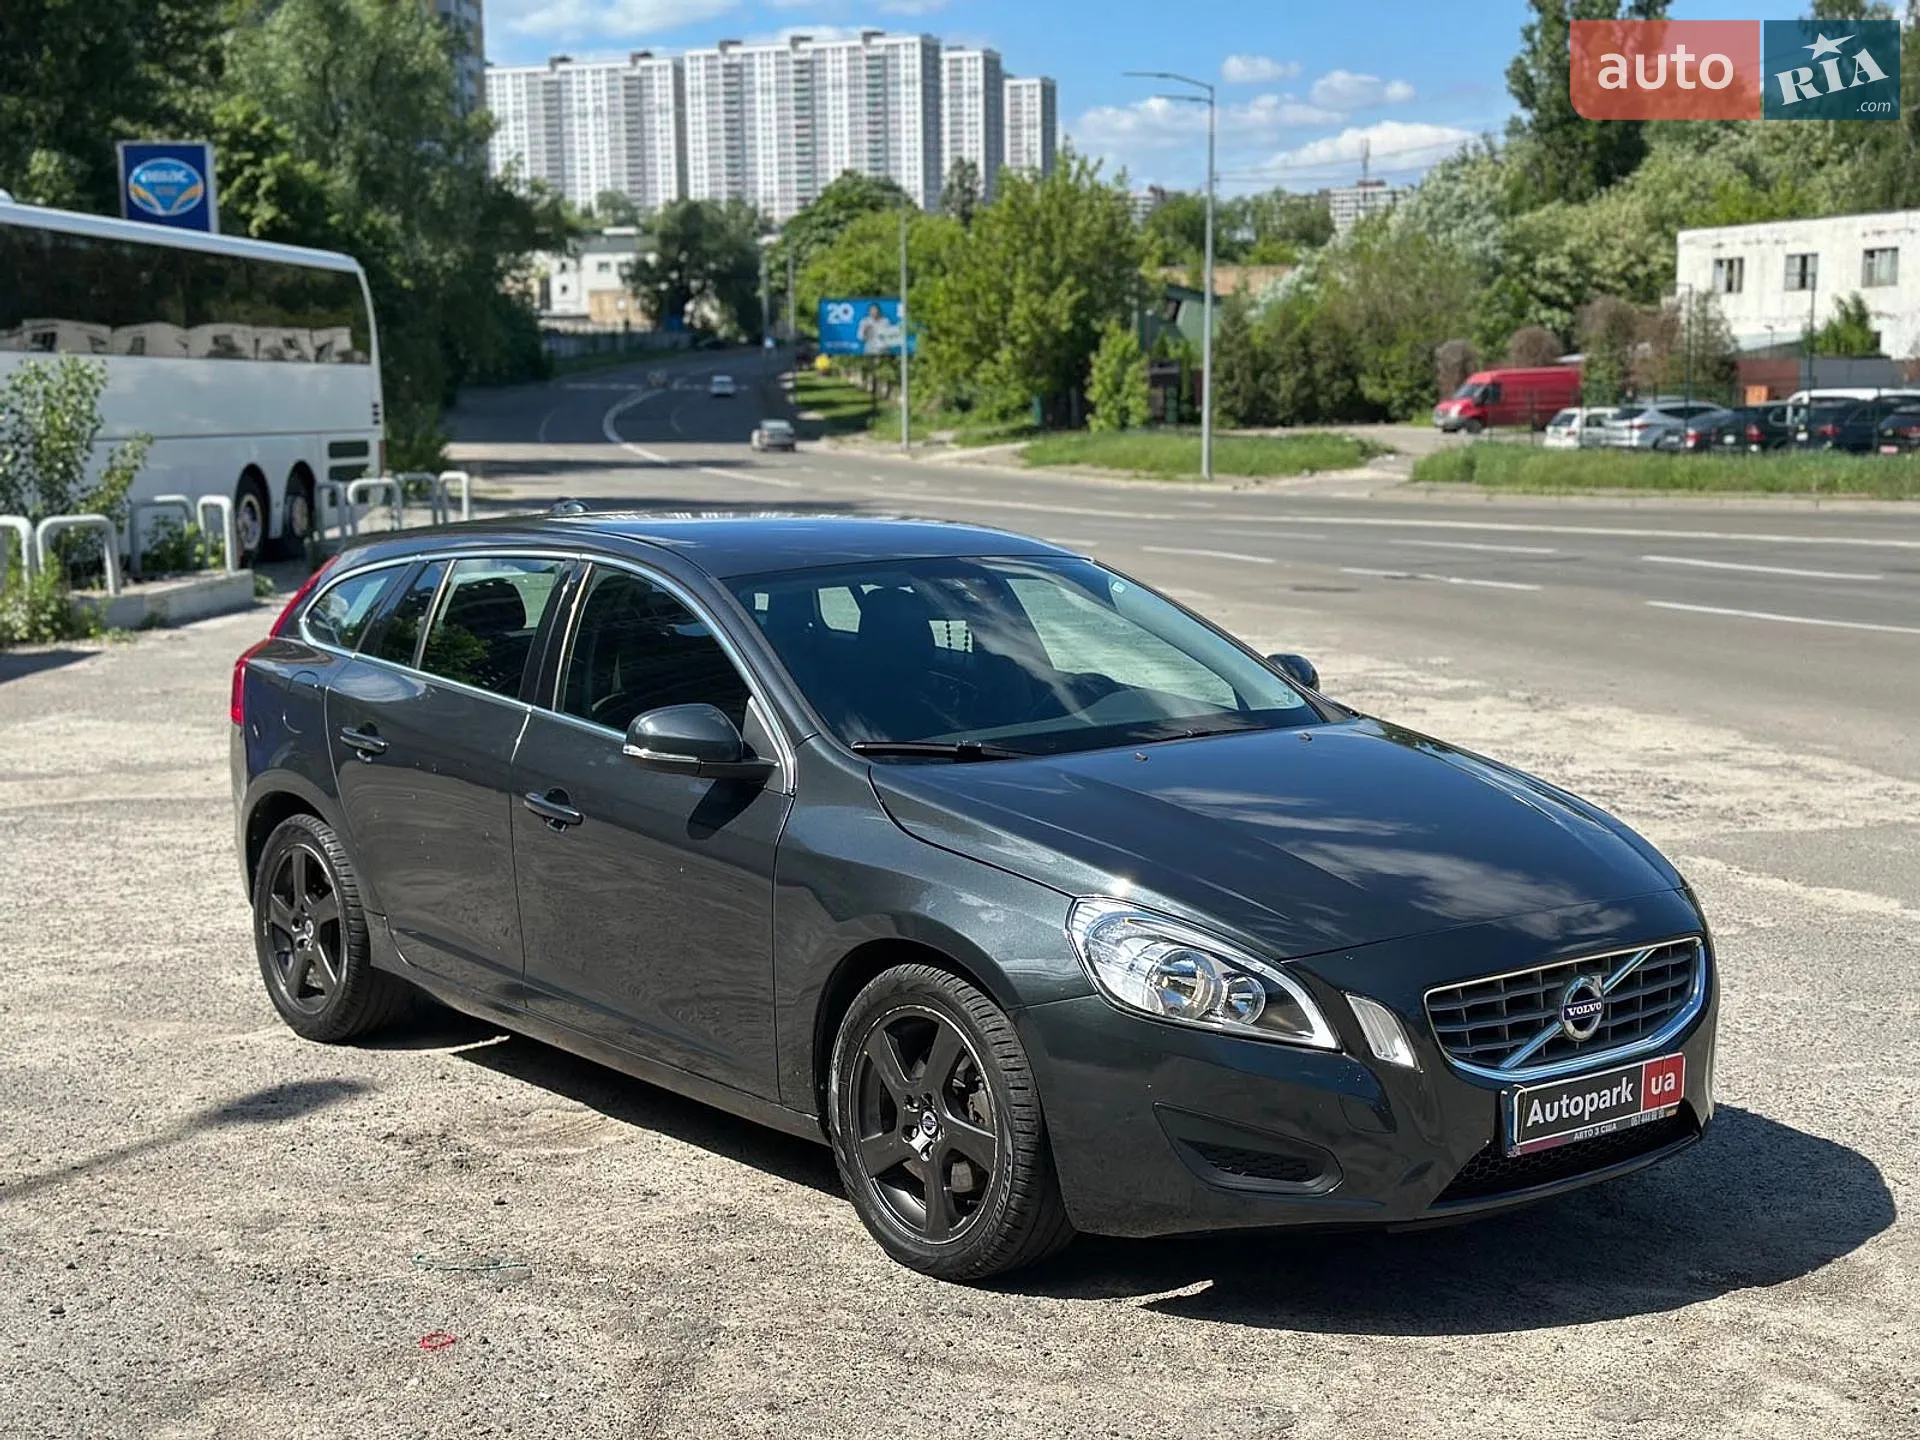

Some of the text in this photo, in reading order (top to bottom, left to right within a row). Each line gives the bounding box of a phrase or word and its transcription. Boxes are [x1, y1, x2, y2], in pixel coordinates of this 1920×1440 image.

[1567, 1002, 1602, 1016] VOLVO
[1526, 1072, 1675, 1127] Autopark ua
